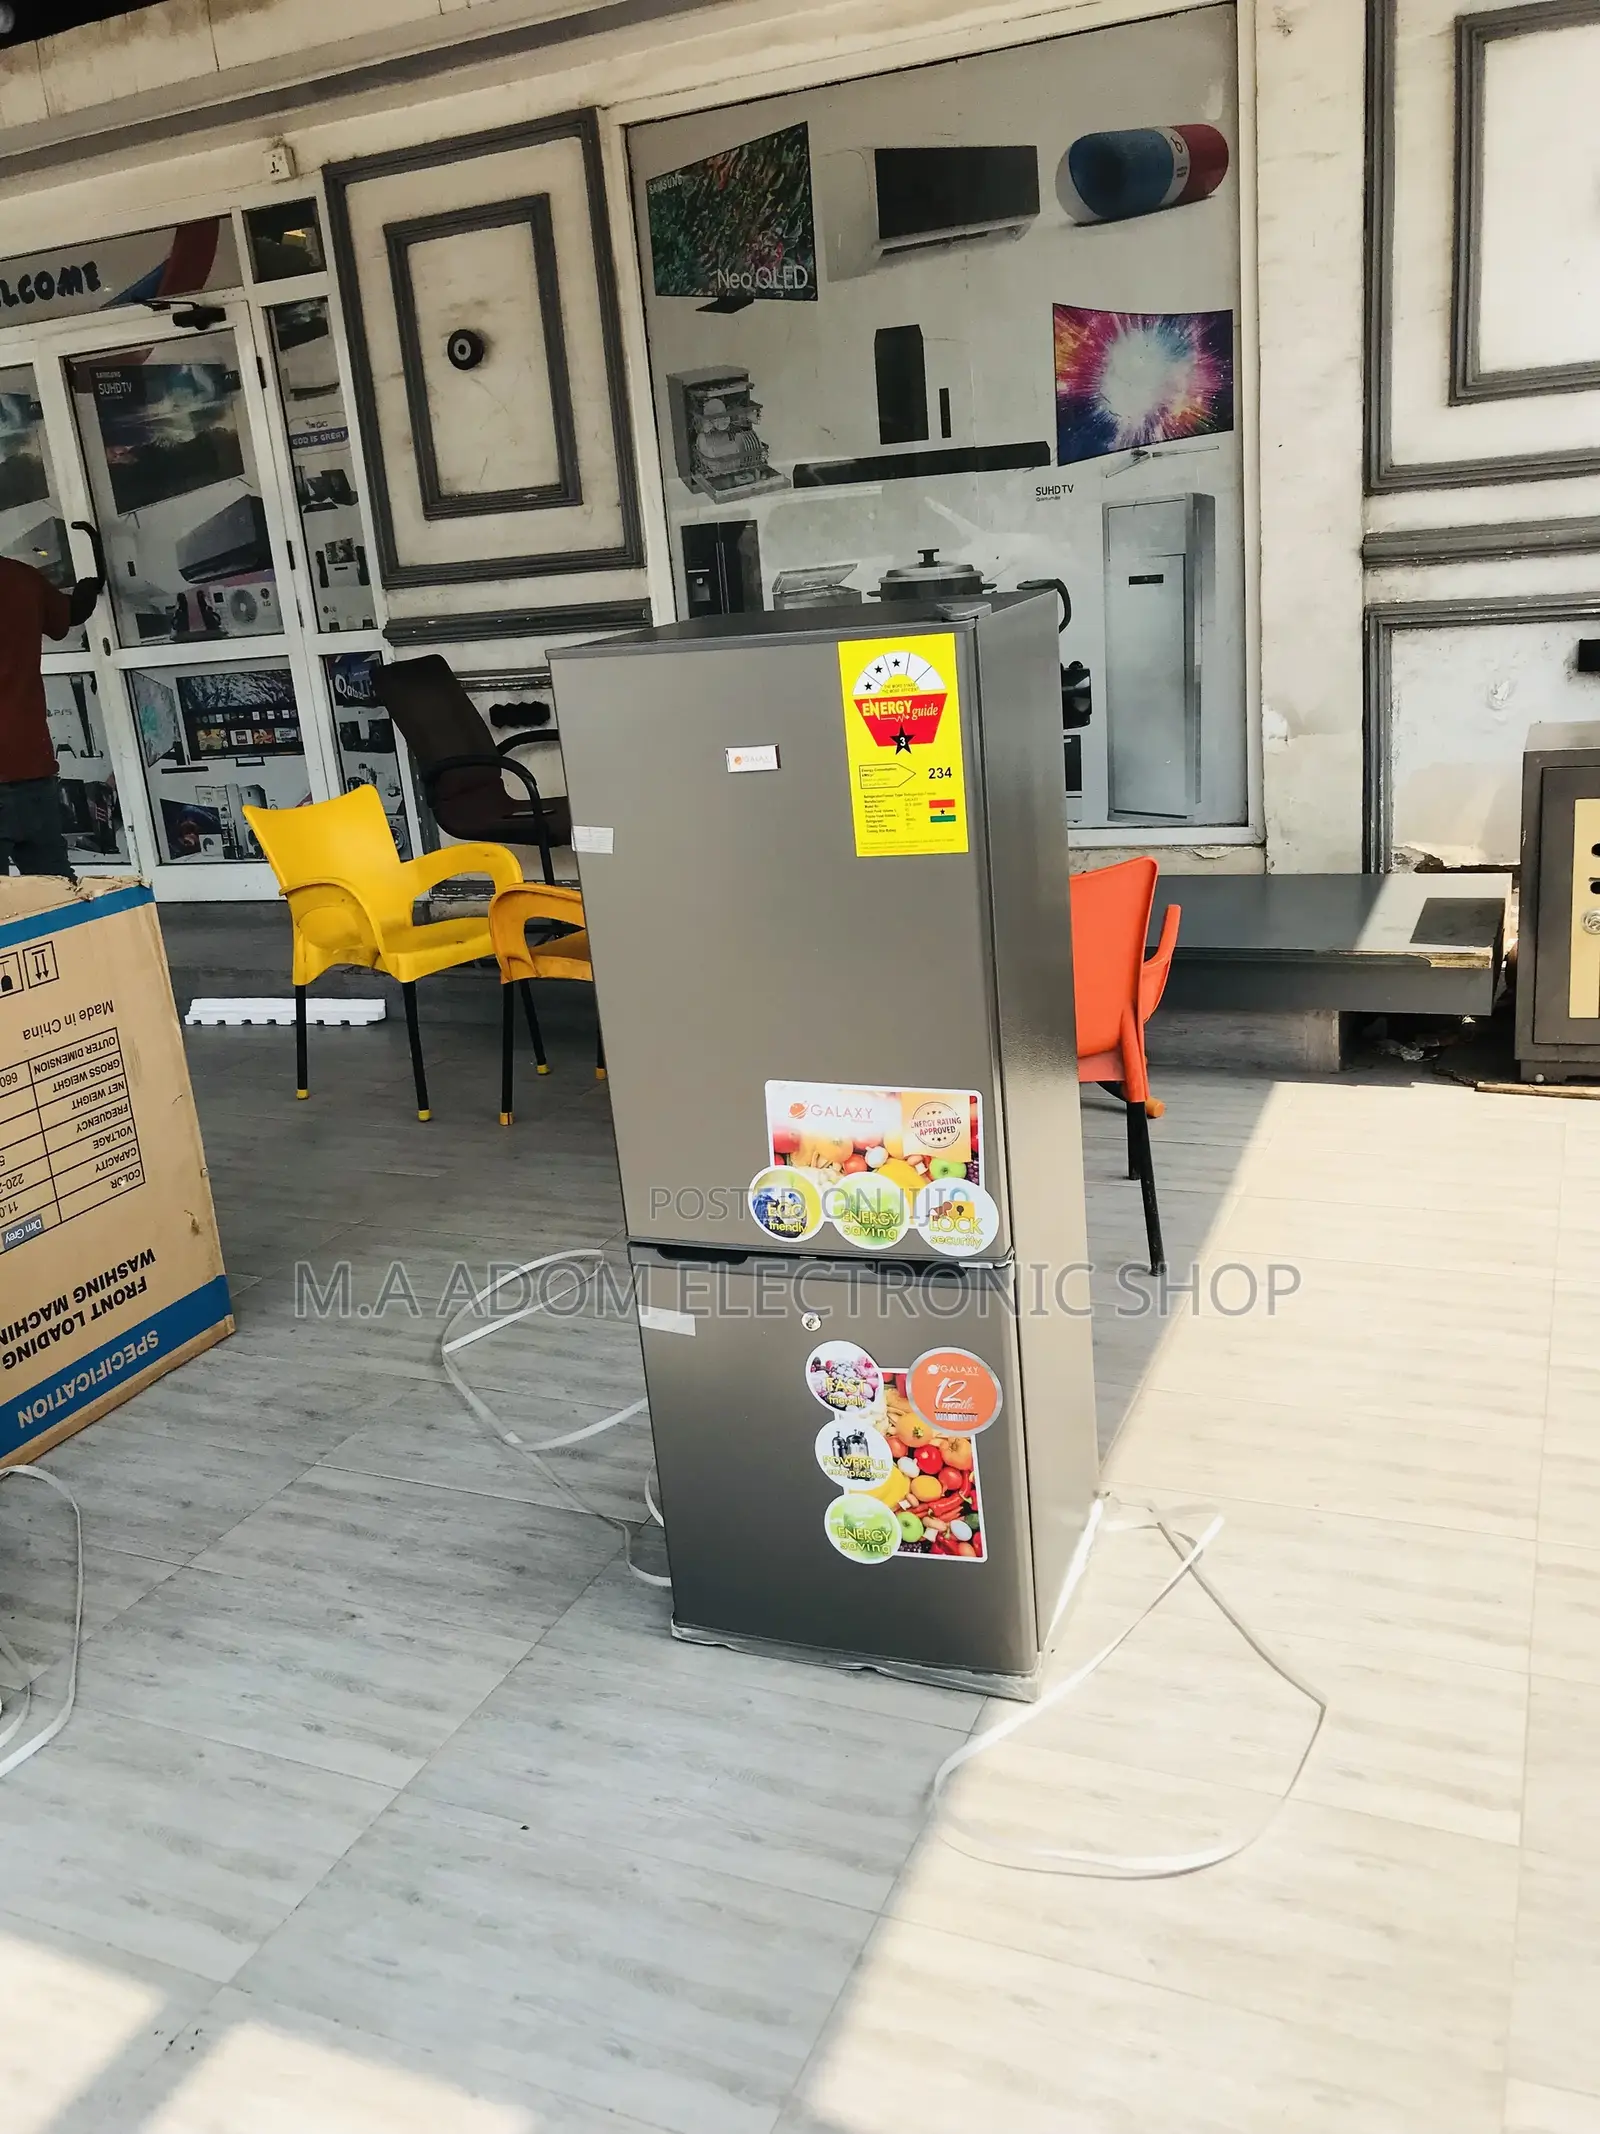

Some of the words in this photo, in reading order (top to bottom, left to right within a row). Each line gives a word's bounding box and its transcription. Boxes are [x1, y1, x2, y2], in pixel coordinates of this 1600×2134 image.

[0, 261, 101, 307] LCOME
[717, 268, 752, 289] Neo
[756, 265, 809, 290] QLED
[862, 698, 912, 720] ENERGY
[911, 703, 939, 720] guide
[900, 736, 906, 747] 3
[928, 767, 952, 780] 234
[64, 1013, 77, 1026] in
[79, 999, 115, 1021] Made
[22, 1019, 62, 1040] China
[86, 1036, 116, 1054] OUTER
[33, 1048, 84, 1074] DIMENSION
[89, 1058, 120, 1078] GROSS
[52, 1073, 88, 1093] WEIGHT
[107, 1081, 125, 1095] NET
[71, 1088, 106, 1110] WEIGHT
[76, 1103, 129, 1134] FREQUENCY
[810, 1104, 874, 1119] GALAXY
[936, 1116, 962, 1126] RATING
[92, 1126, 133, 1149] VOLTAGE
[919, 1126, 956, 1136] APPROVED
[95, 1147, 137, 1173] CAPACITY
[110, 1169, 141, 1189] COLOR
[767, 1201, 808, 1218] ECO
[842, 1209, 899, 1226] ENERGY
[25, 1219, 42, 1233] Dim
[843, 1224, 898, 1241] saving
[929, 1214, 983, 1235] LOCK
[5, 1228, 25, 1244] Grey
[930, 1235, 983, 1249] security
[72, 1248, 156, 1304] WASHING
[91, 1276, 148, 1321] FRONT
[2, 1310, 86, 1370] LOADING
[940, 1364, 979, 1374] GALAXY
[17, 1330, 159, 1429] SPECIFICATION
[825, 1377, 867, 1393] FAST
[934, 1377, 967, 1409] 12
[823, 1455, 889, 1471] POWERFUL
[837, 1526, 891, 1542] ENERGY
[840, 1540, 891, 1556] saving
